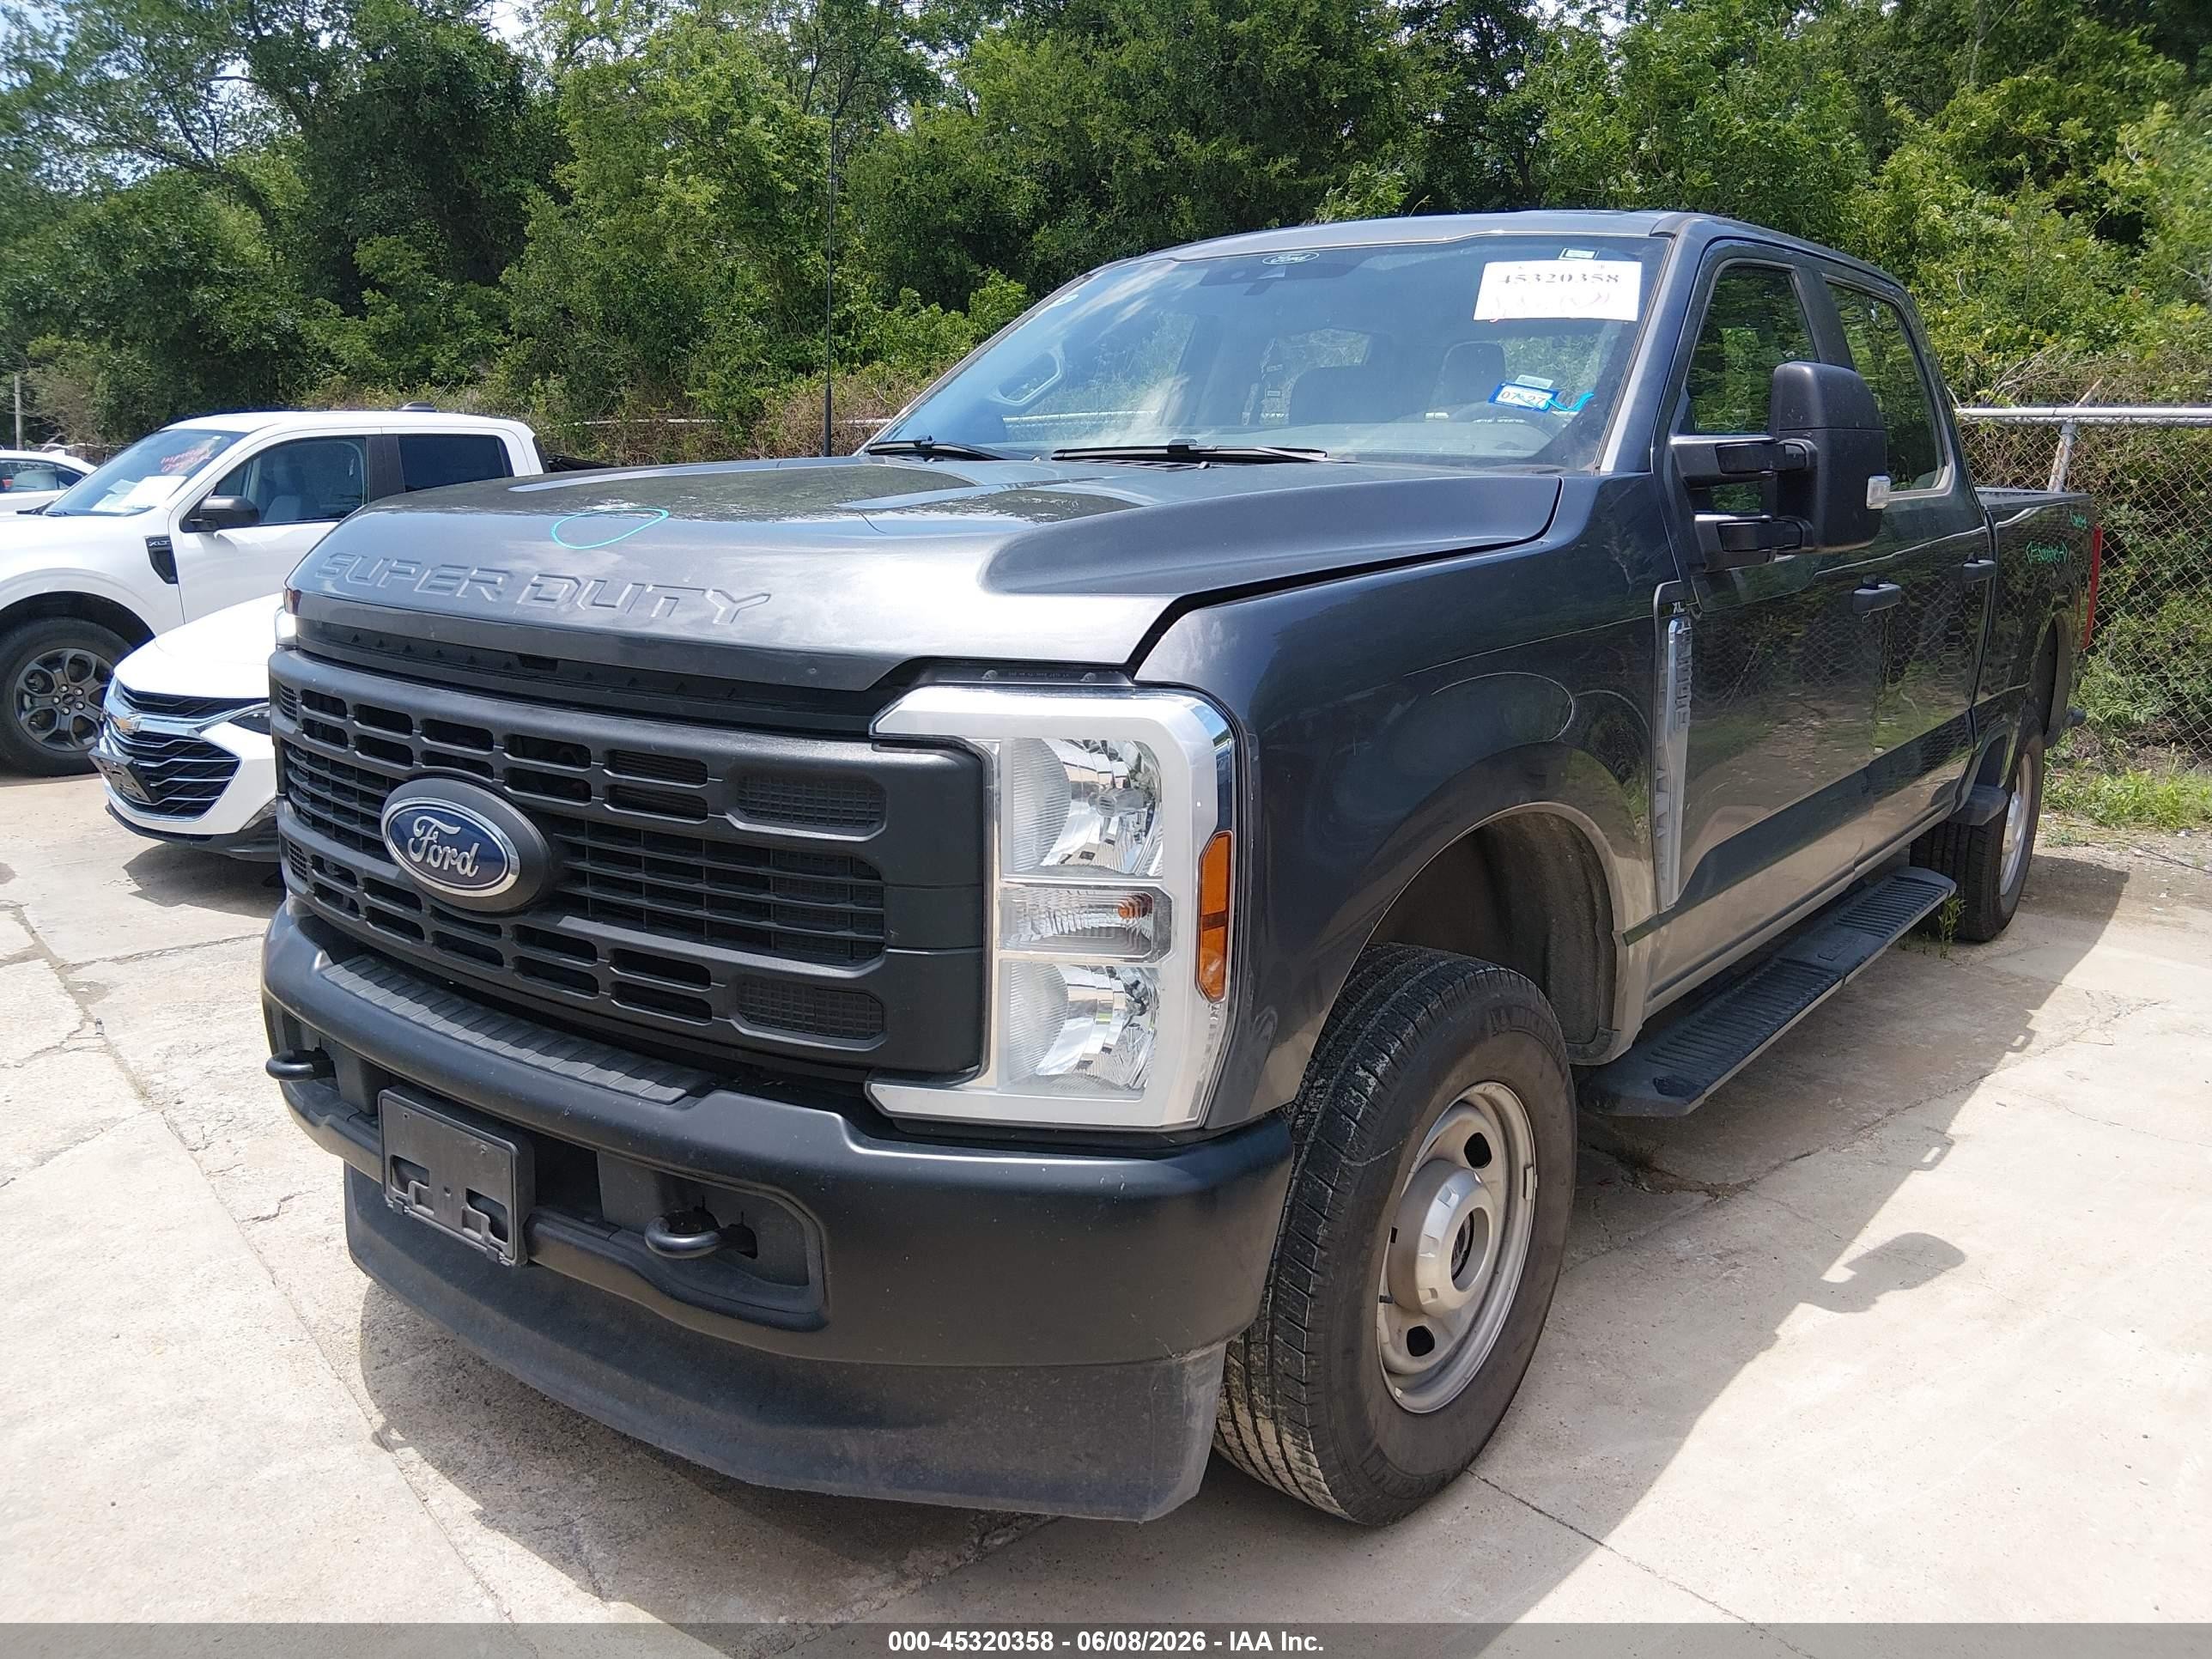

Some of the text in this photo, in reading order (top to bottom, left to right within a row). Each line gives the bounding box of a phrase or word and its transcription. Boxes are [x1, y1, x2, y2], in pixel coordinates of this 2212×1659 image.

[1271, 252, 1310, 263] Ford
[1500, 273, 1620, 284] 45320358
[315, 552, 771, 625] SUPER DUTY
[1672, 601, 1685, 614] XL
[407, 815, 481, 878] Ford
